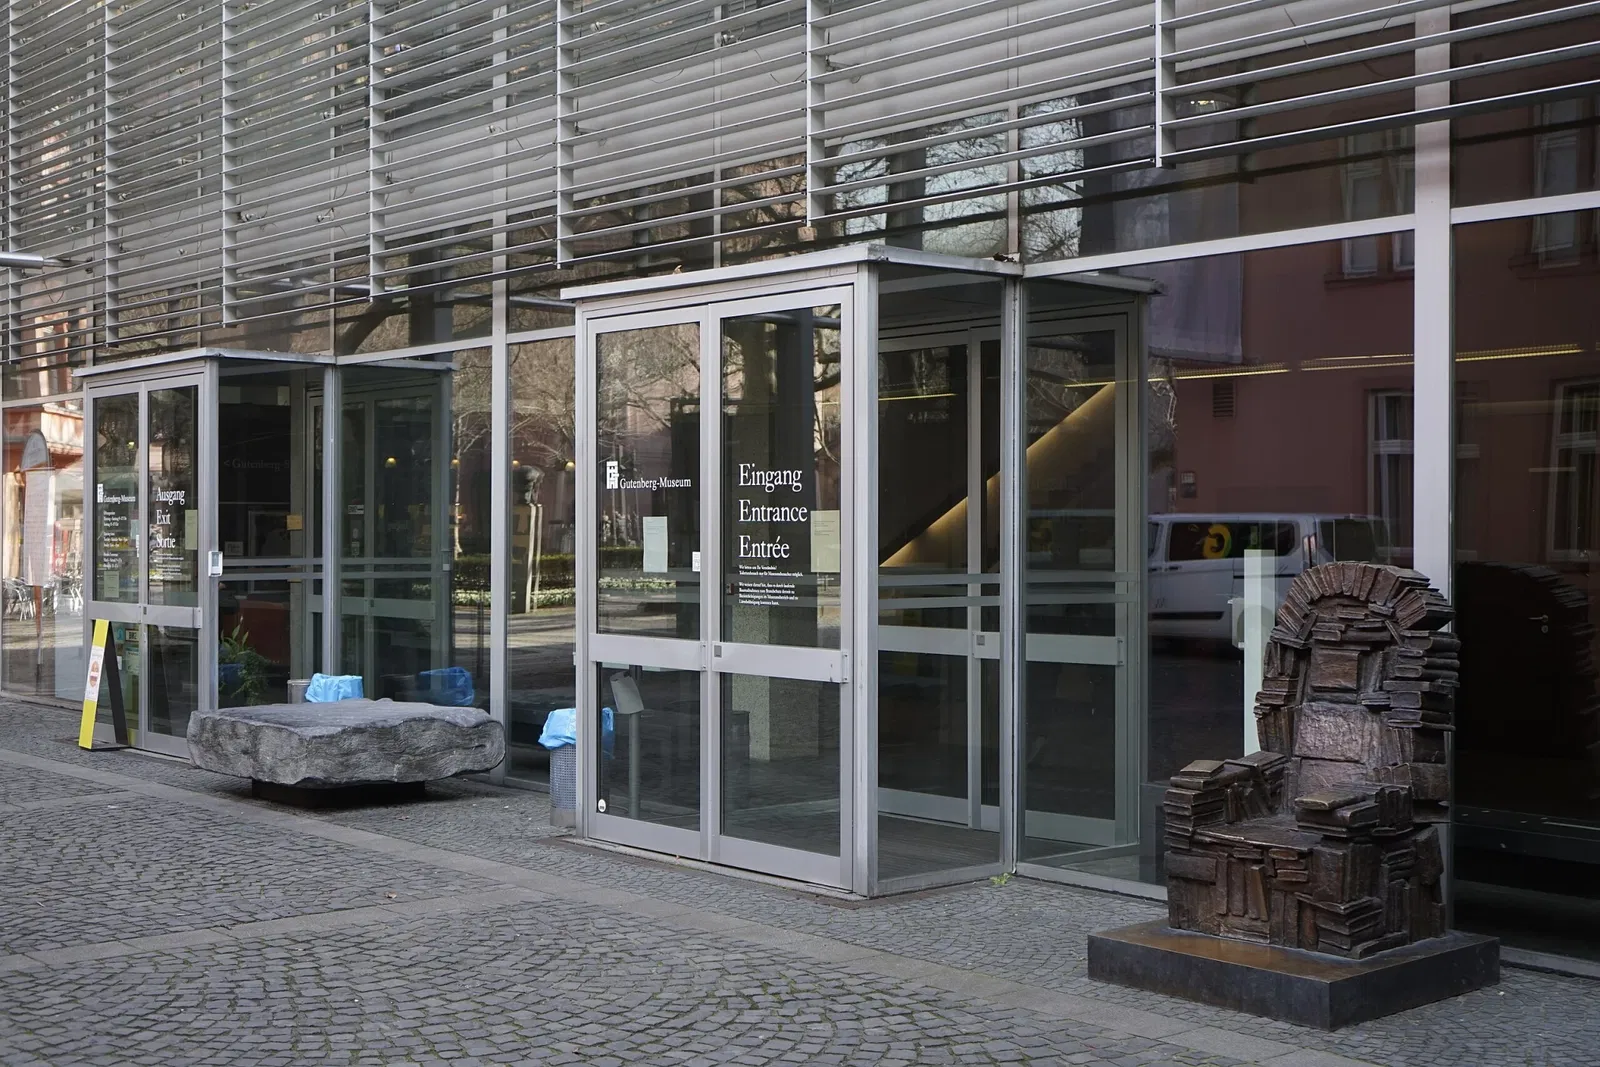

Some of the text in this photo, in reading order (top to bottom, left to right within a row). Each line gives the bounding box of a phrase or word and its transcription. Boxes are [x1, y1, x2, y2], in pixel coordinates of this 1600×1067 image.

[620, 477, 691, 491] Gutenberg-Museum
[739, 463, 802, 493] Eingang
[156, 487, 185, 506] Ausgang
[156, 509, 171, 525] Exit
[739, 499, 808, 522] Entrance
[156, 533, 176, 548] Sortie
[739, 535, 790, 558] Entrée
